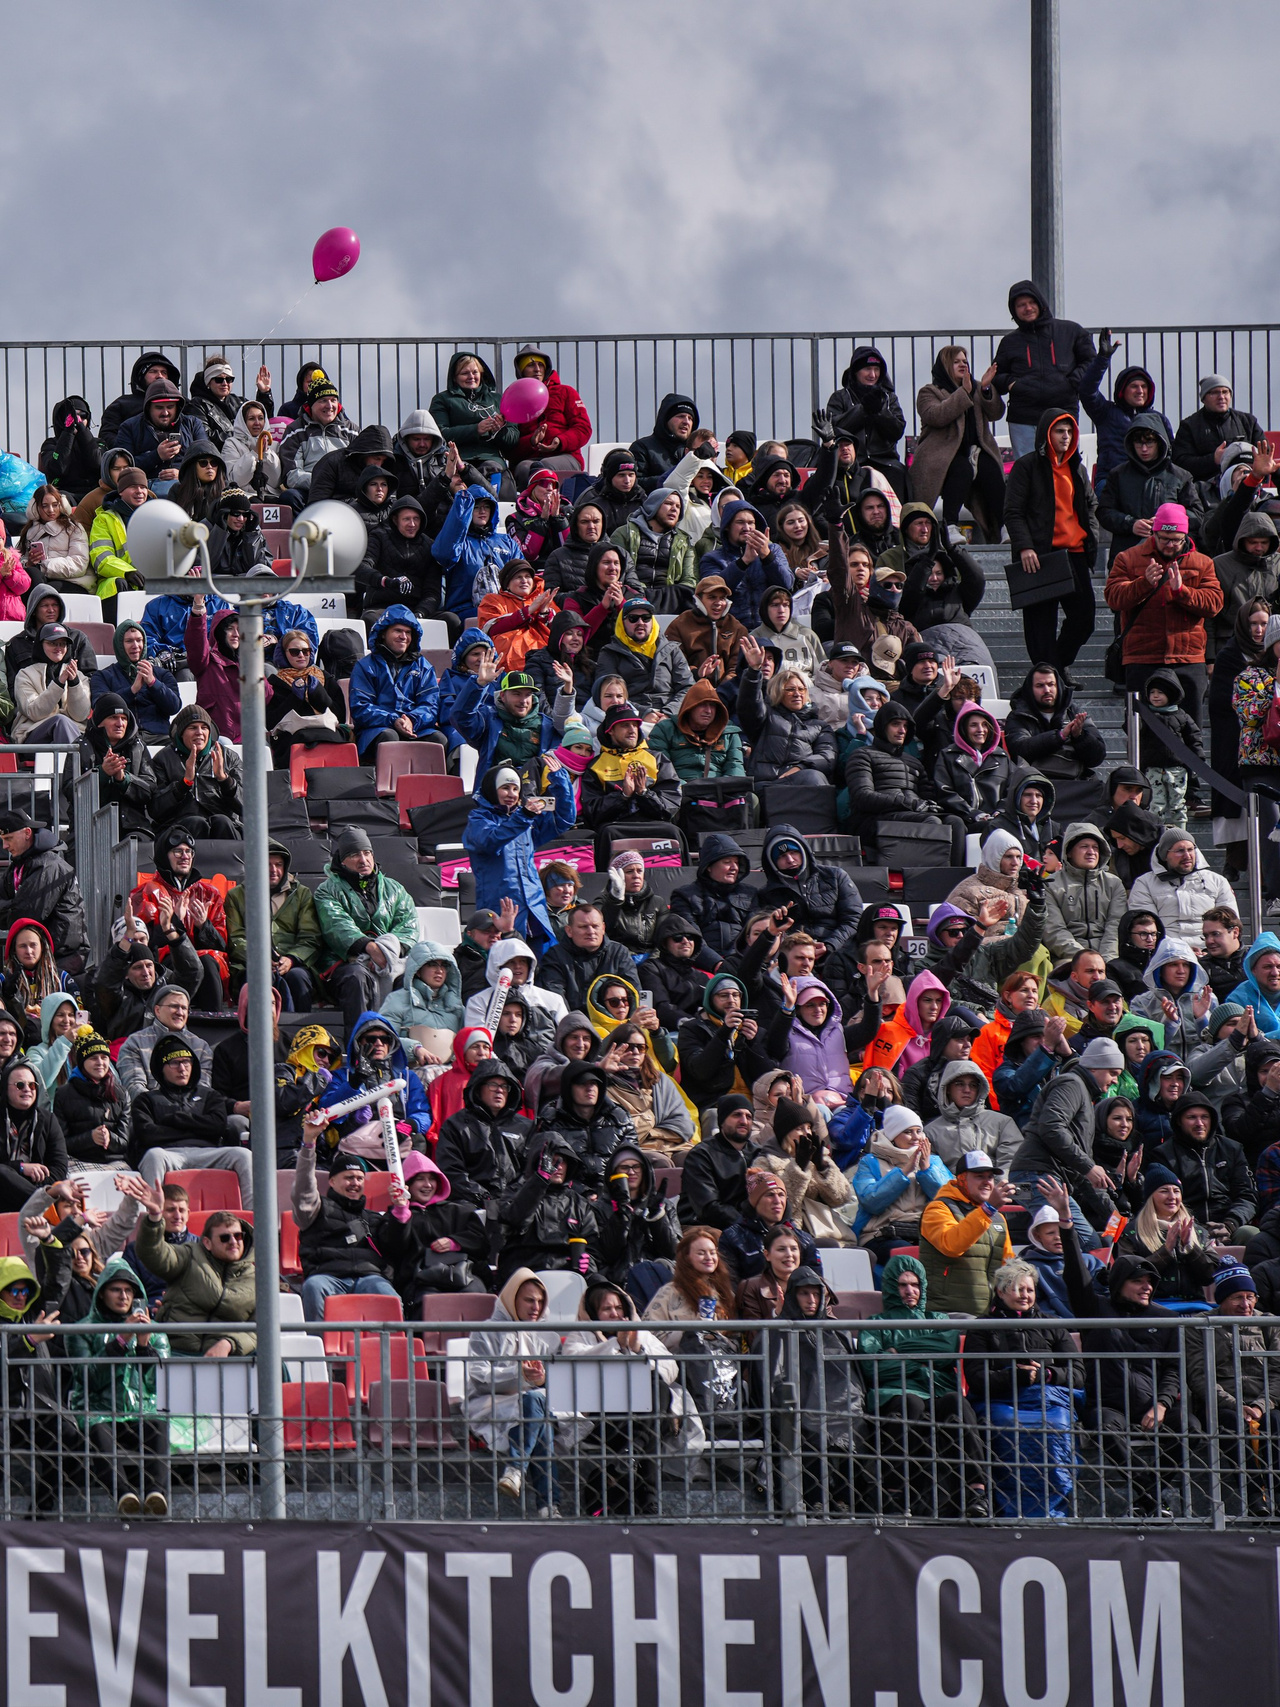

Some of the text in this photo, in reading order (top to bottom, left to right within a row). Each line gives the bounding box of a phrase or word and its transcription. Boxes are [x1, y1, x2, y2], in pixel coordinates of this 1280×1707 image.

[265, 508, 279, 521] 24
[321, 598, 336, 610] 24
[972, 672, 986, 685] 31
[910, 942, 926, 956] 26
[490, 990, 507, 1031] TAKAYAMA
[875, 1038, 894, 1053] CR
[340, 1085, 383, 1106] TAKAYAMA
[385, 1119, 397, 1164] TAKAYAMA
